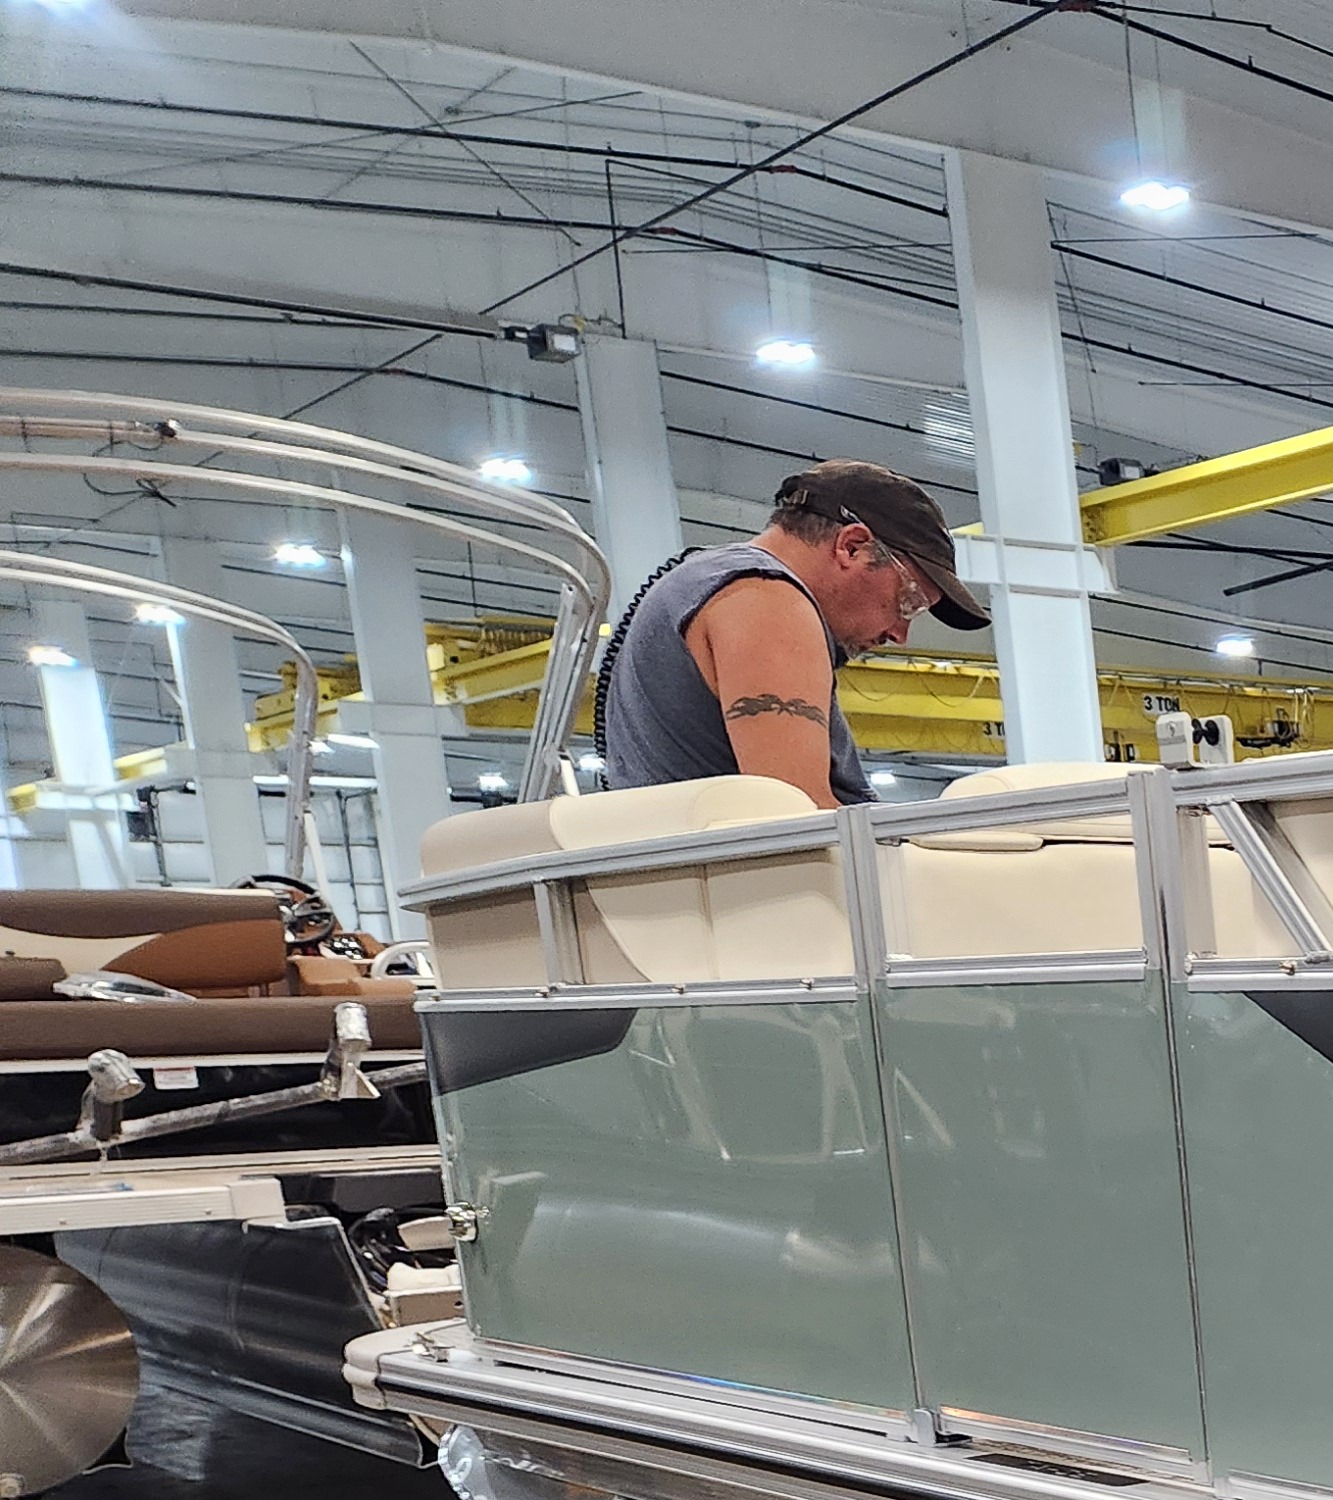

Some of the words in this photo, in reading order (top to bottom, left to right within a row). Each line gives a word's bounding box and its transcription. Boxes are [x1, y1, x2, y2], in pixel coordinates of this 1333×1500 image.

[1143, 695, 1153, 711] 3
[1155, 696, 1181, 712] TON
[982, 721, 992, 736] 3
